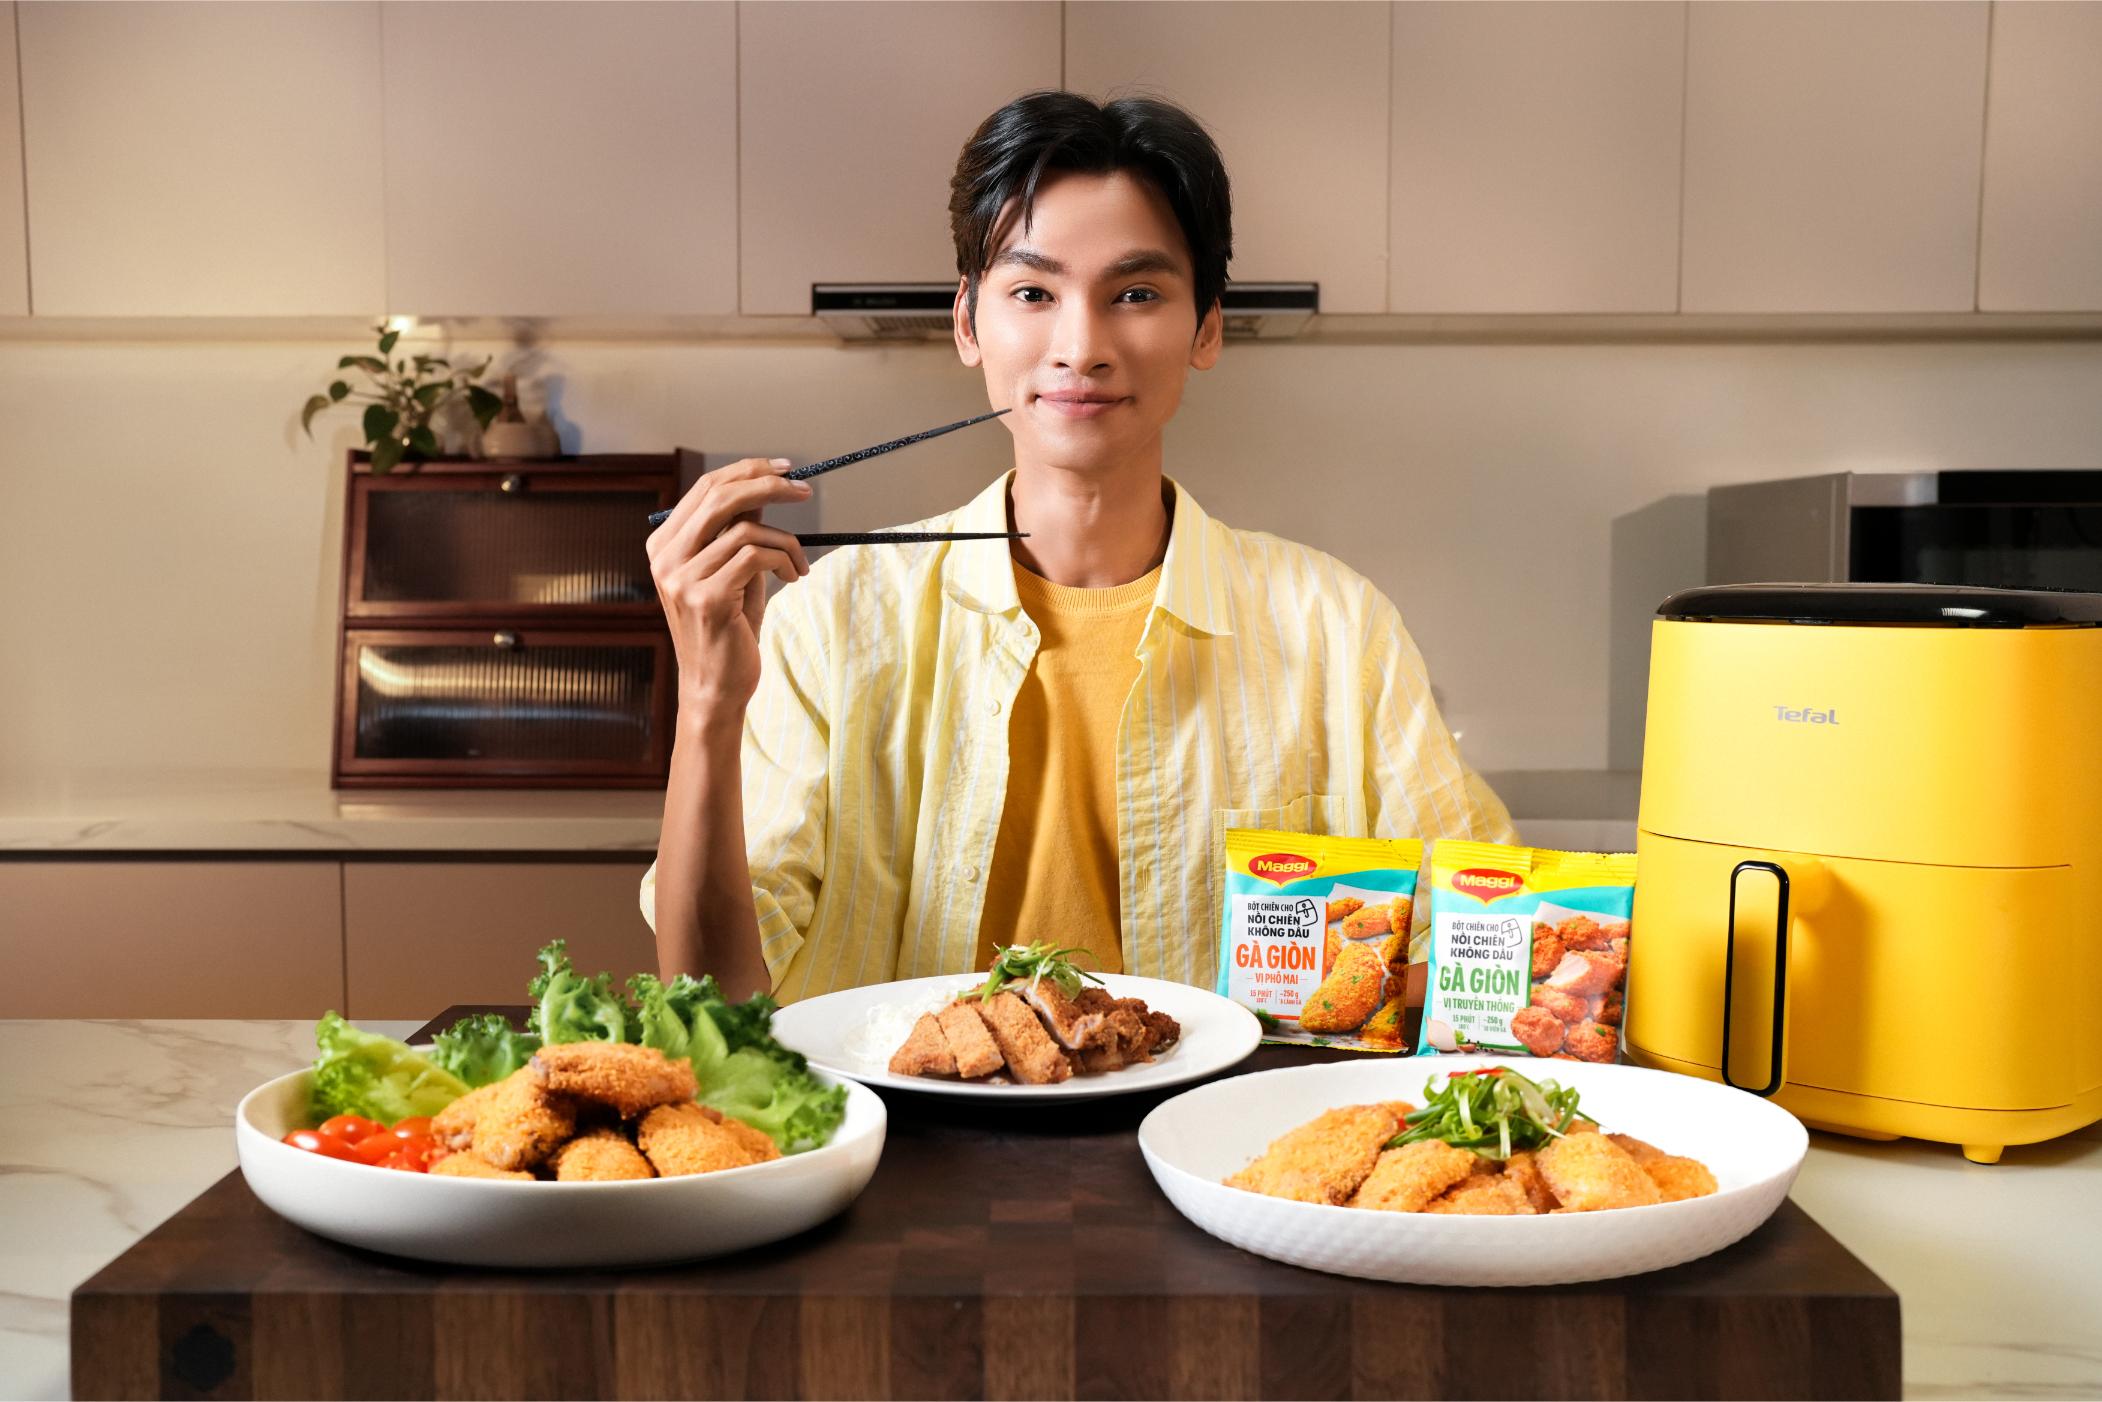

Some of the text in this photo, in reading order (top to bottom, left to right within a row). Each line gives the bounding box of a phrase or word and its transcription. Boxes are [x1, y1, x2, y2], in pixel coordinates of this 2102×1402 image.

[1773, 705, 1840, 725] Tefal
[1257, 860, 1309, 872] Maggi
[1460, 874, 1515, 889] Maggi
[1261, 901, 1280, 912] CHIÊN
[1281, 903, 1294, 912] CHO
[1268, 914, 1301, 926] CHIÊN
[1466, 921, 1485, 932] CHIÊN
[1486, 923, 1499, 932] CHO
[1248, 925, 1285, 938] KHÔNG
[1473, 934, 1505, 947] CHIÊN
[1235, 940, 1316, 971] GÀ GIÒN
[1450, 946, 1490, 960] KHÔNG
[1283, 974, 1299, 985] MAI
[1439, 962, 1520, 996] GÀ GIÒN
[1443, 997, 1452, 1011] VỊ
